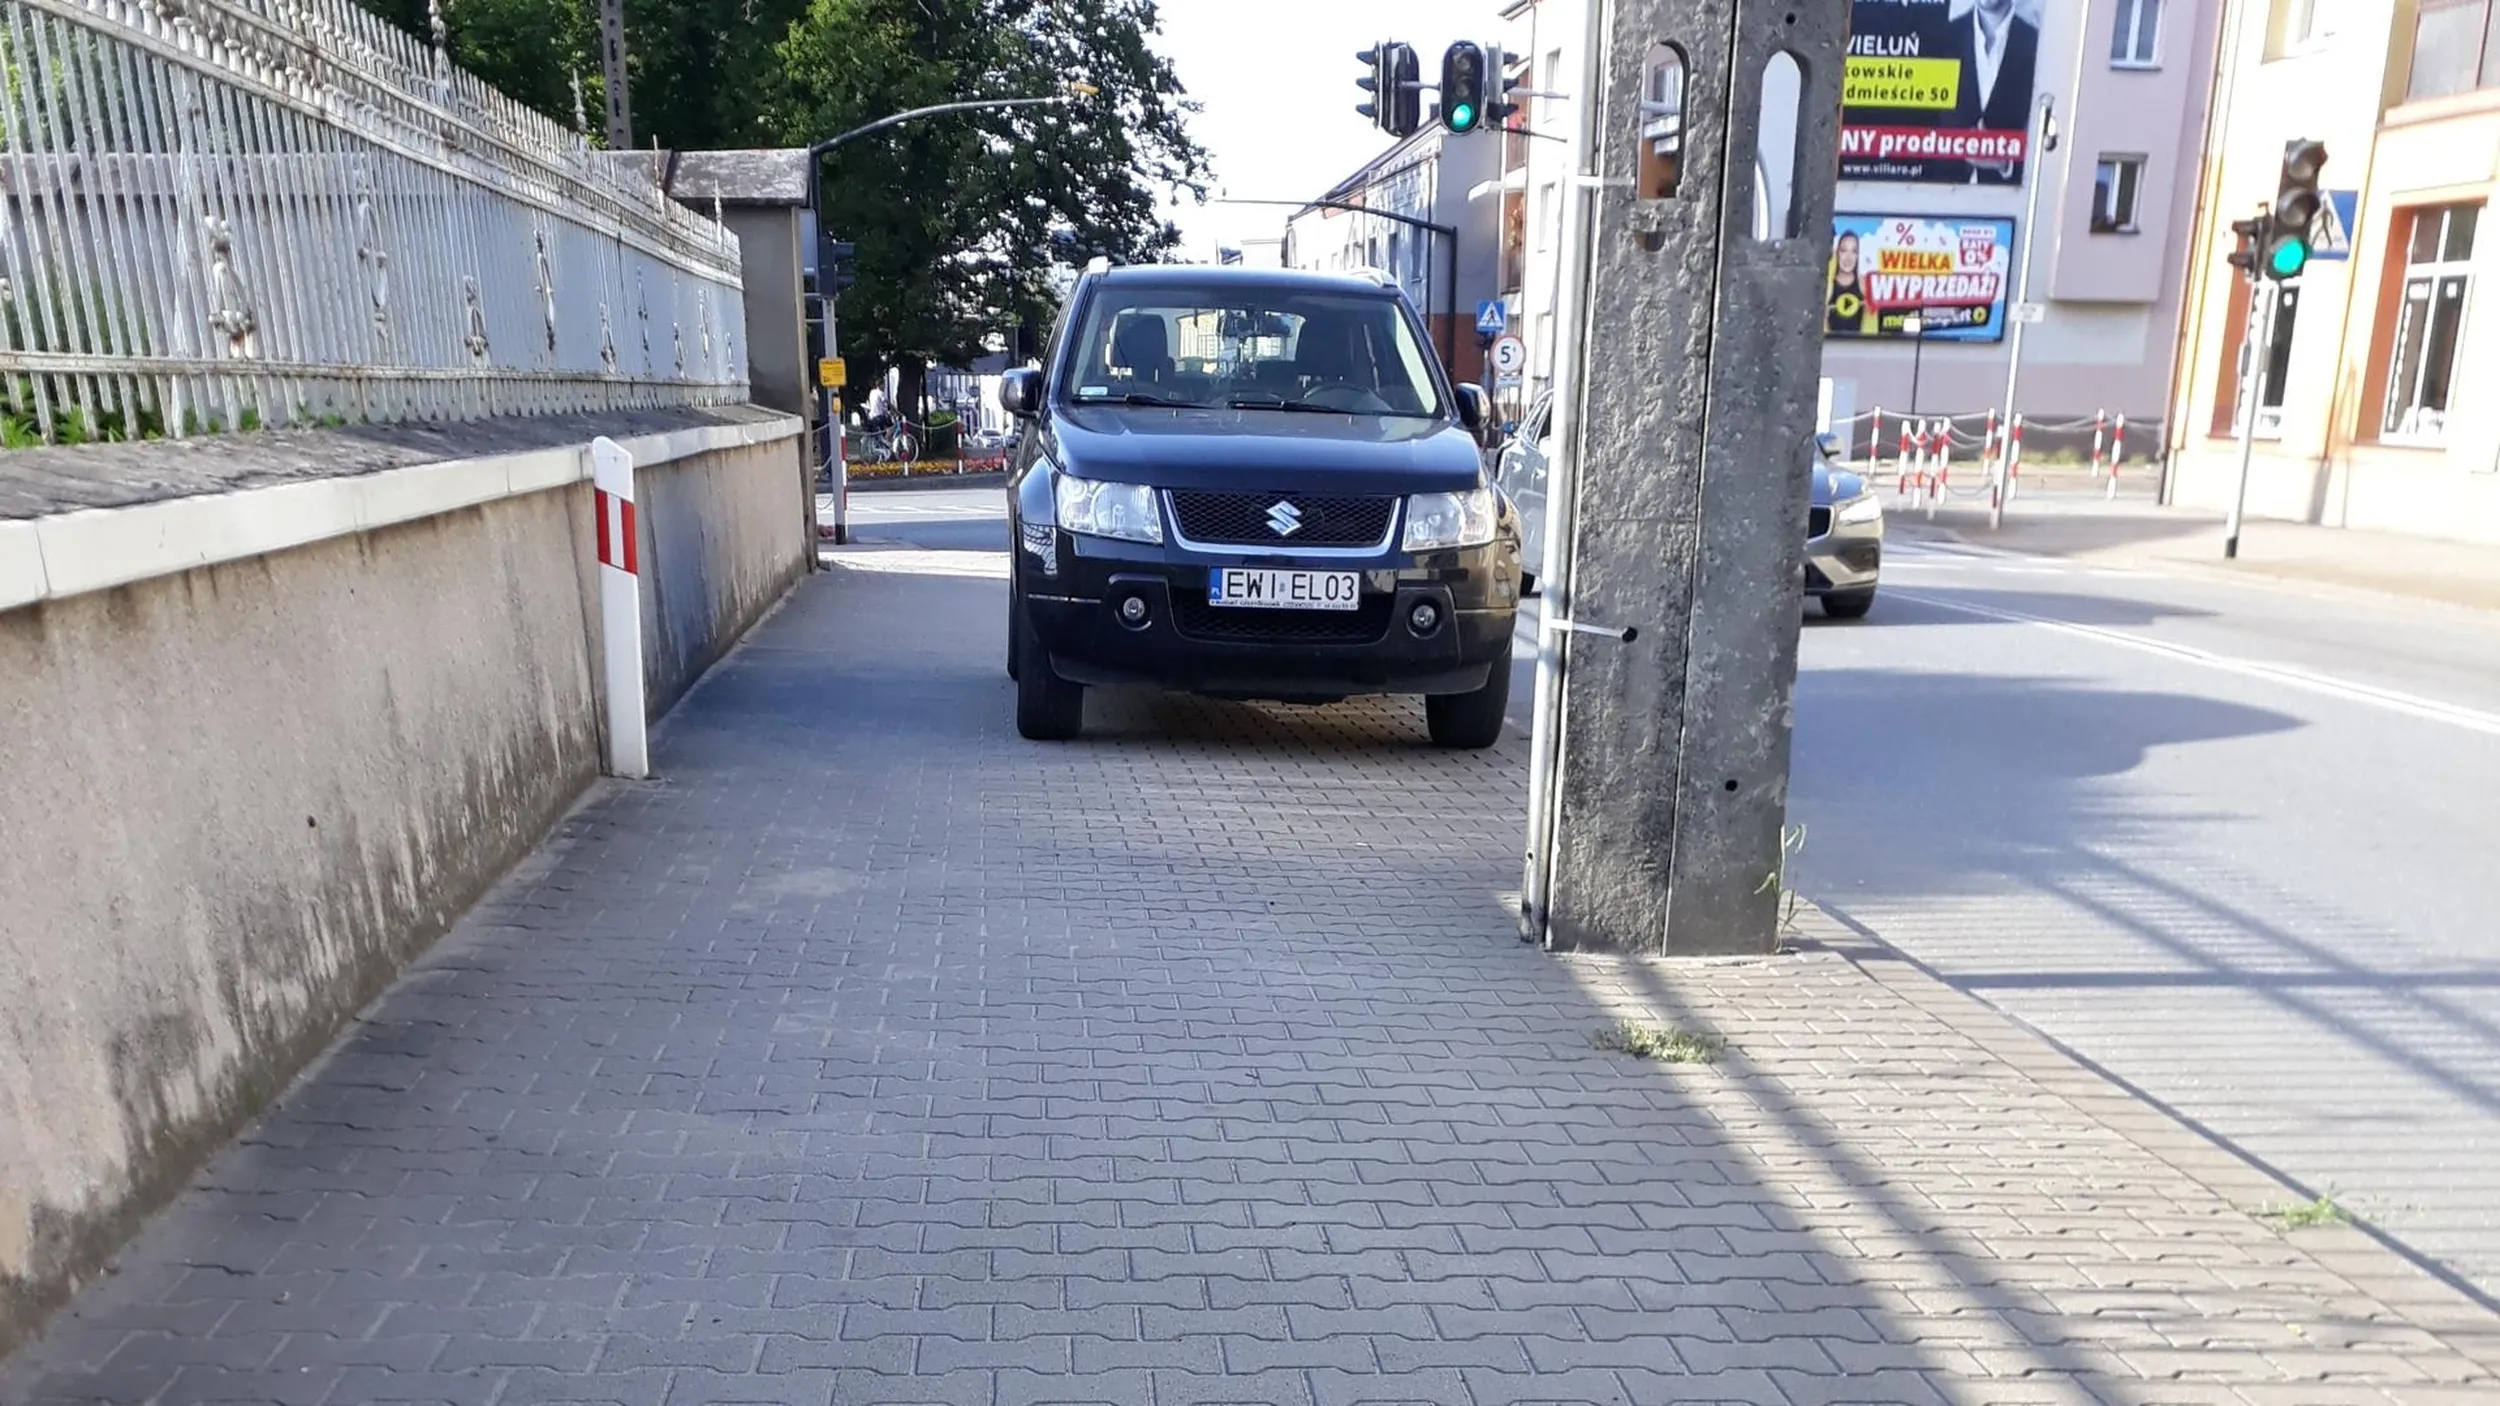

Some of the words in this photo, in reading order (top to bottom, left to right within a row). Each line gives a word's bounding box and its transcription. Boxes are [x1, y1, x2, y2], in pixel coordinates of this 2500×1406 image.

[1929, 87, 1949, 101] 50
[1841, 129, 1877, 153] NY
[1879, 130, 2021, 158] producenta
[1881, 249, 1951, 270] WIELKA
[1227, 571, 1276, 599] EWI
[1292, 574, 1355, 601] EL03
